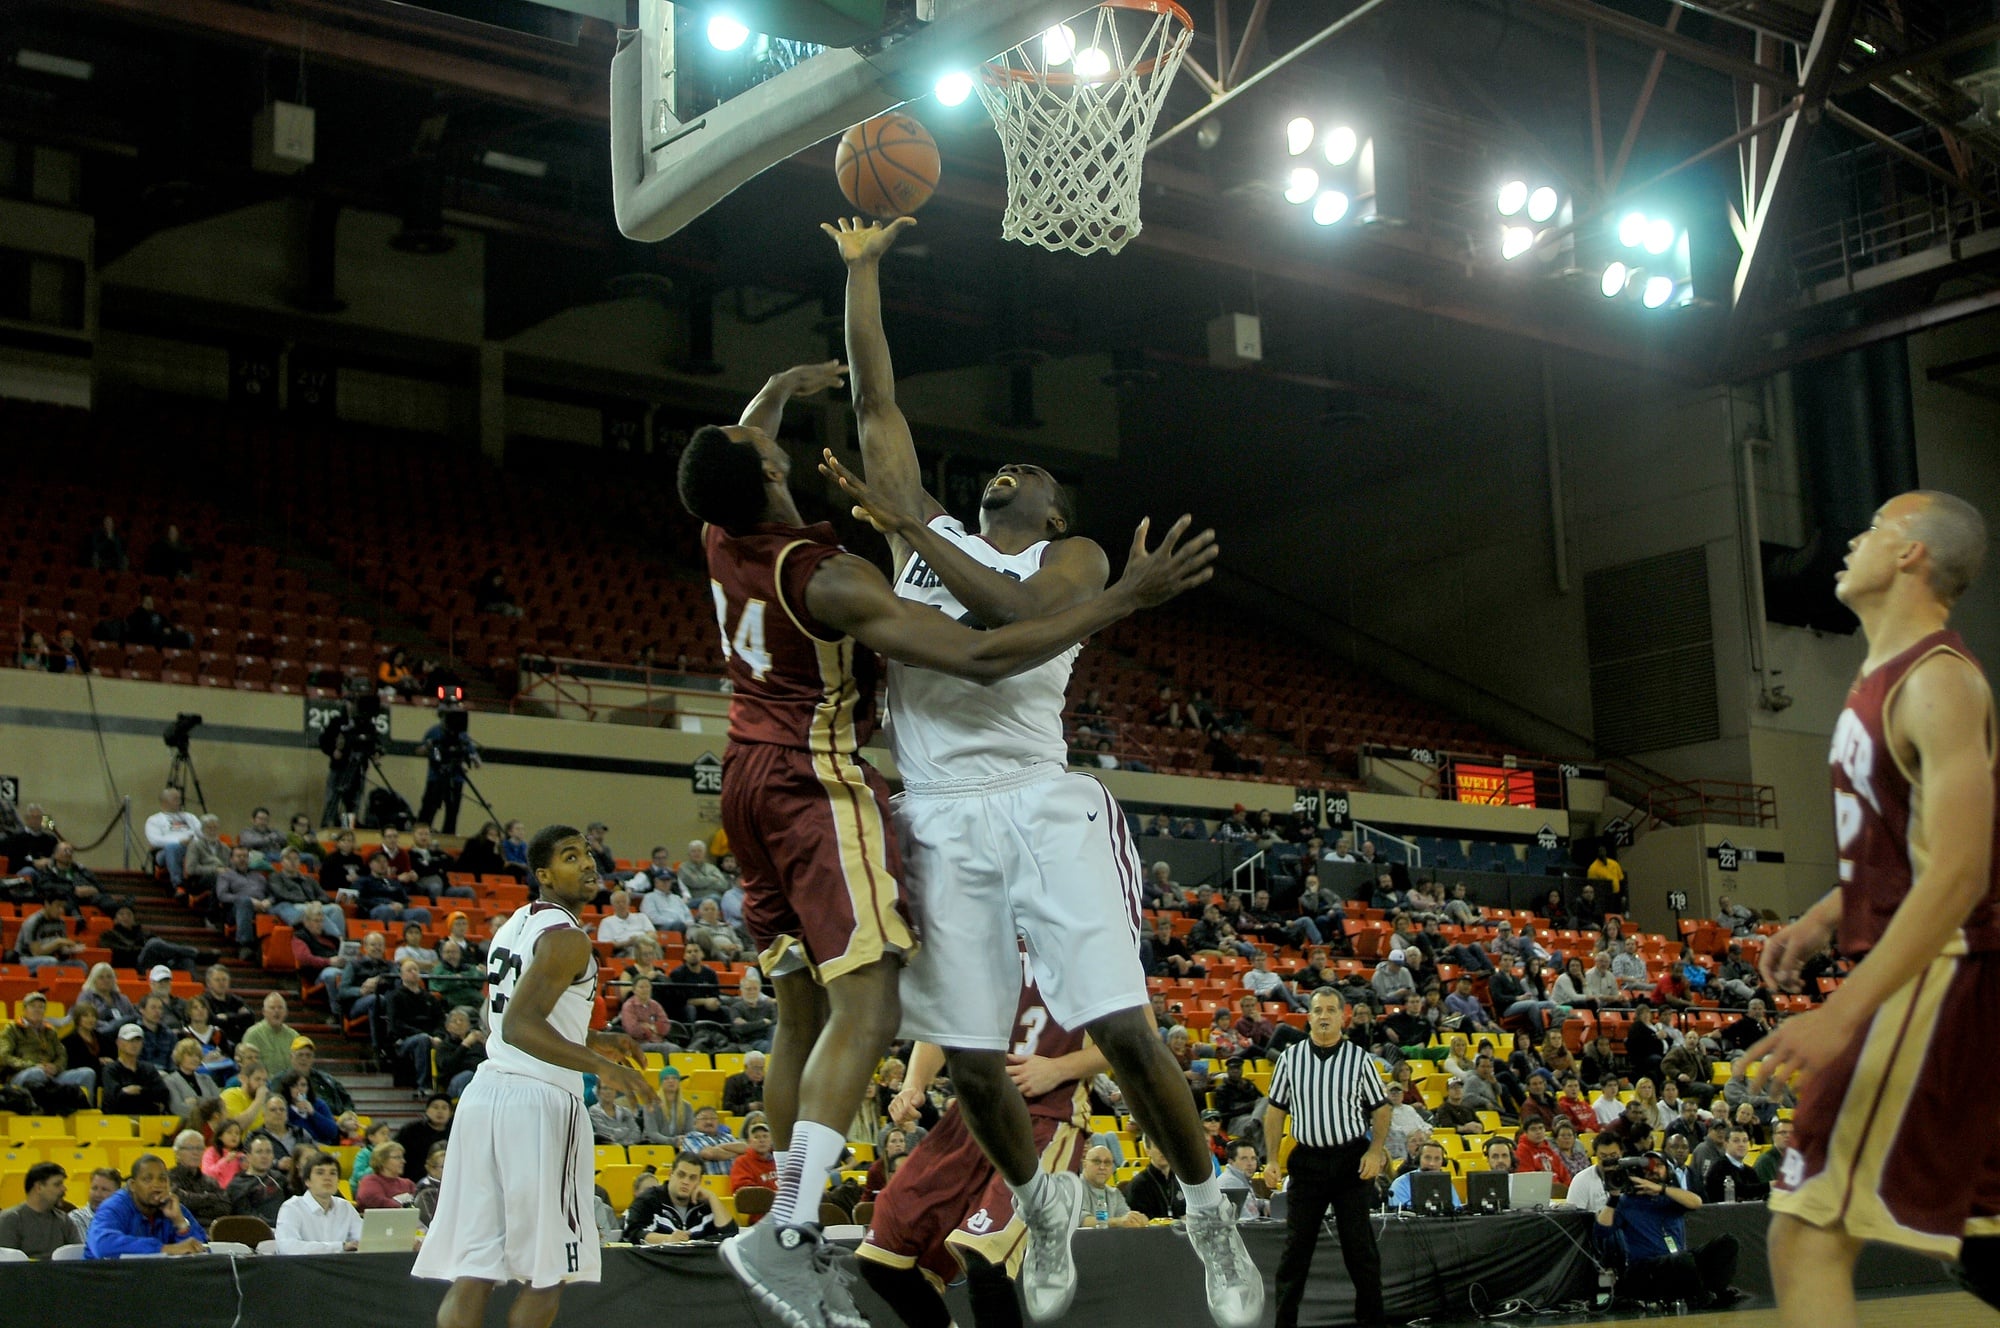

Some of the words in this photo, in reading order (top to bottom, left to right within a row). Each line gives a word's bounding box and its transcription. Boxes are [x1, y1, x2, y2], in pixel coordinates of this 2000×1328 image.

[696, 771, 722, 792] 215
[1298, 795, 1319, 812] 217
[1327, 797, 1348, 815] 219
[1720, 854, 1737, 868] 221
[1015, 1005, 1048, 1057] 3
[564, 1241, 580, 1272] H
